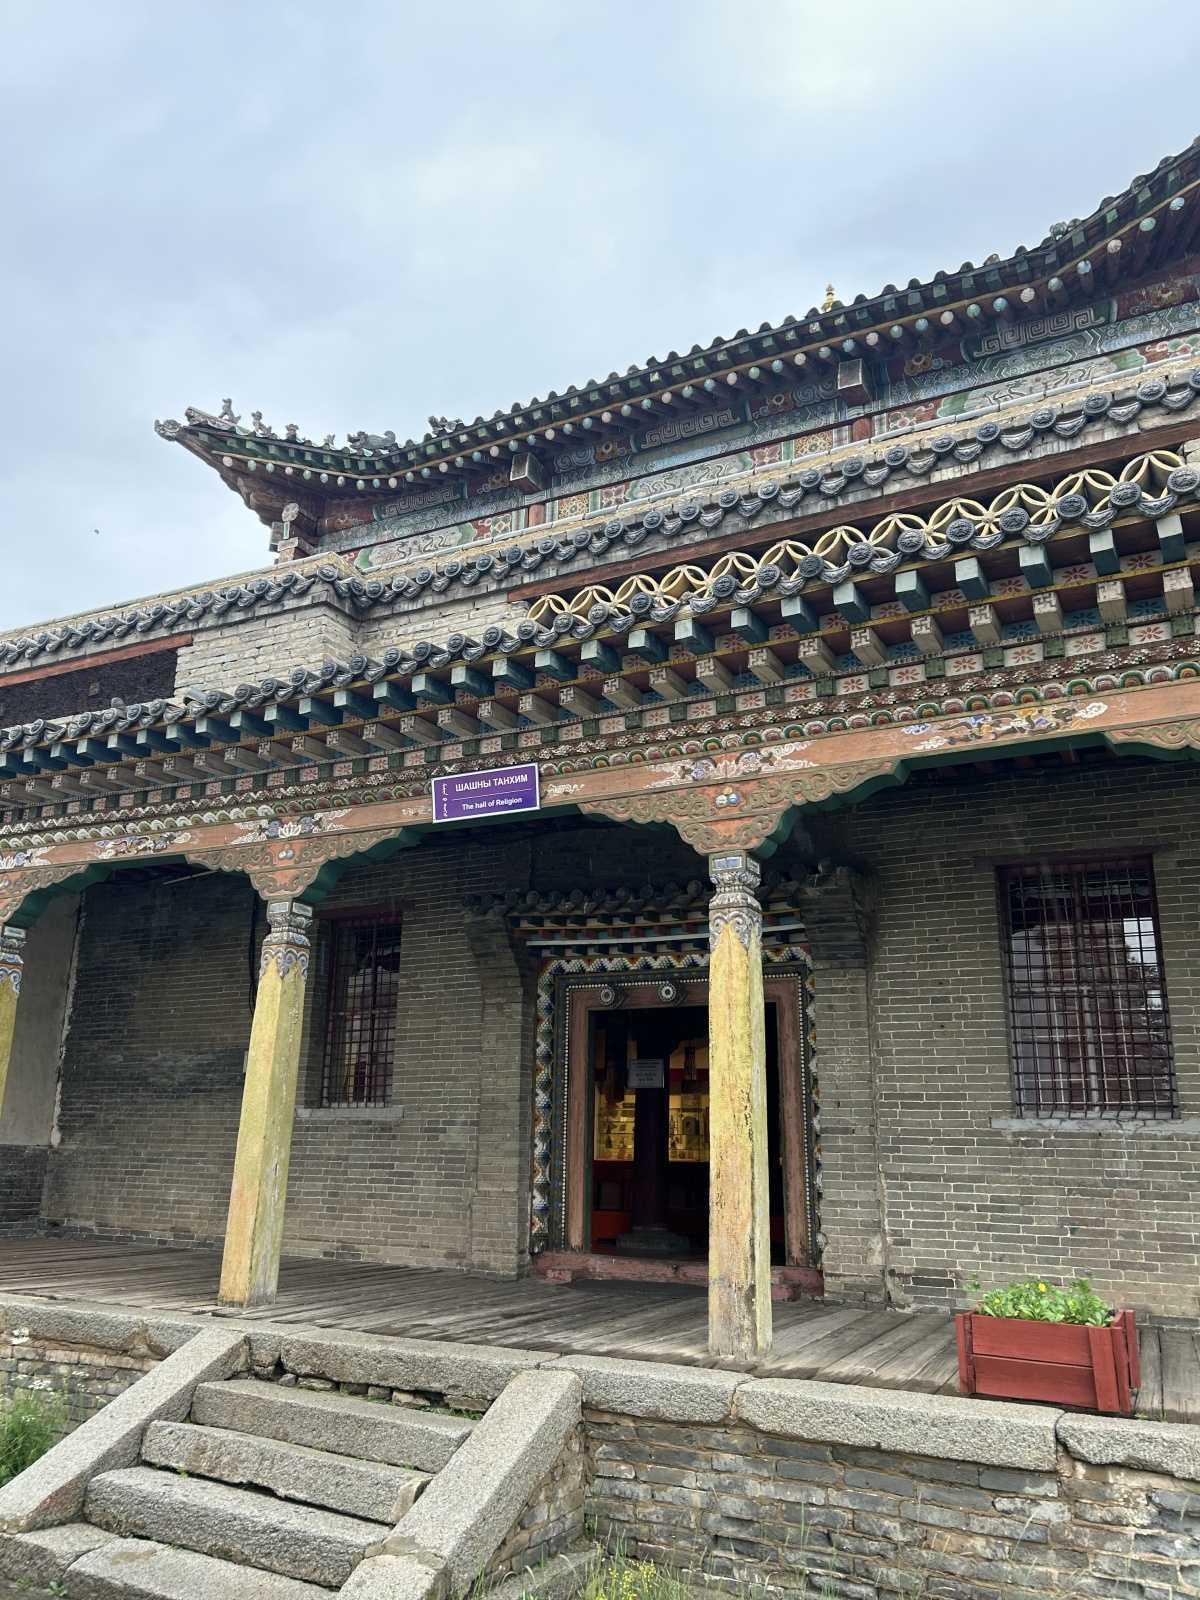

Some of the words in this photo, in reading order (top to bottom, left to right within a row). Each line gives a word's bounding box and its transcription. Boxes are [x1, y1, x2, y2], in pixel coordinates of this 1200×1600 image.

[455, 779, 491, 792] ШАШНЫ
[492, 774, 528, 786] ТАНХИМ
[462, 803, 474, 811] The
[475, 801, 487, 809] hall
[487, 799, 495, 808] of
[495, 797, 523, 806] Religion
